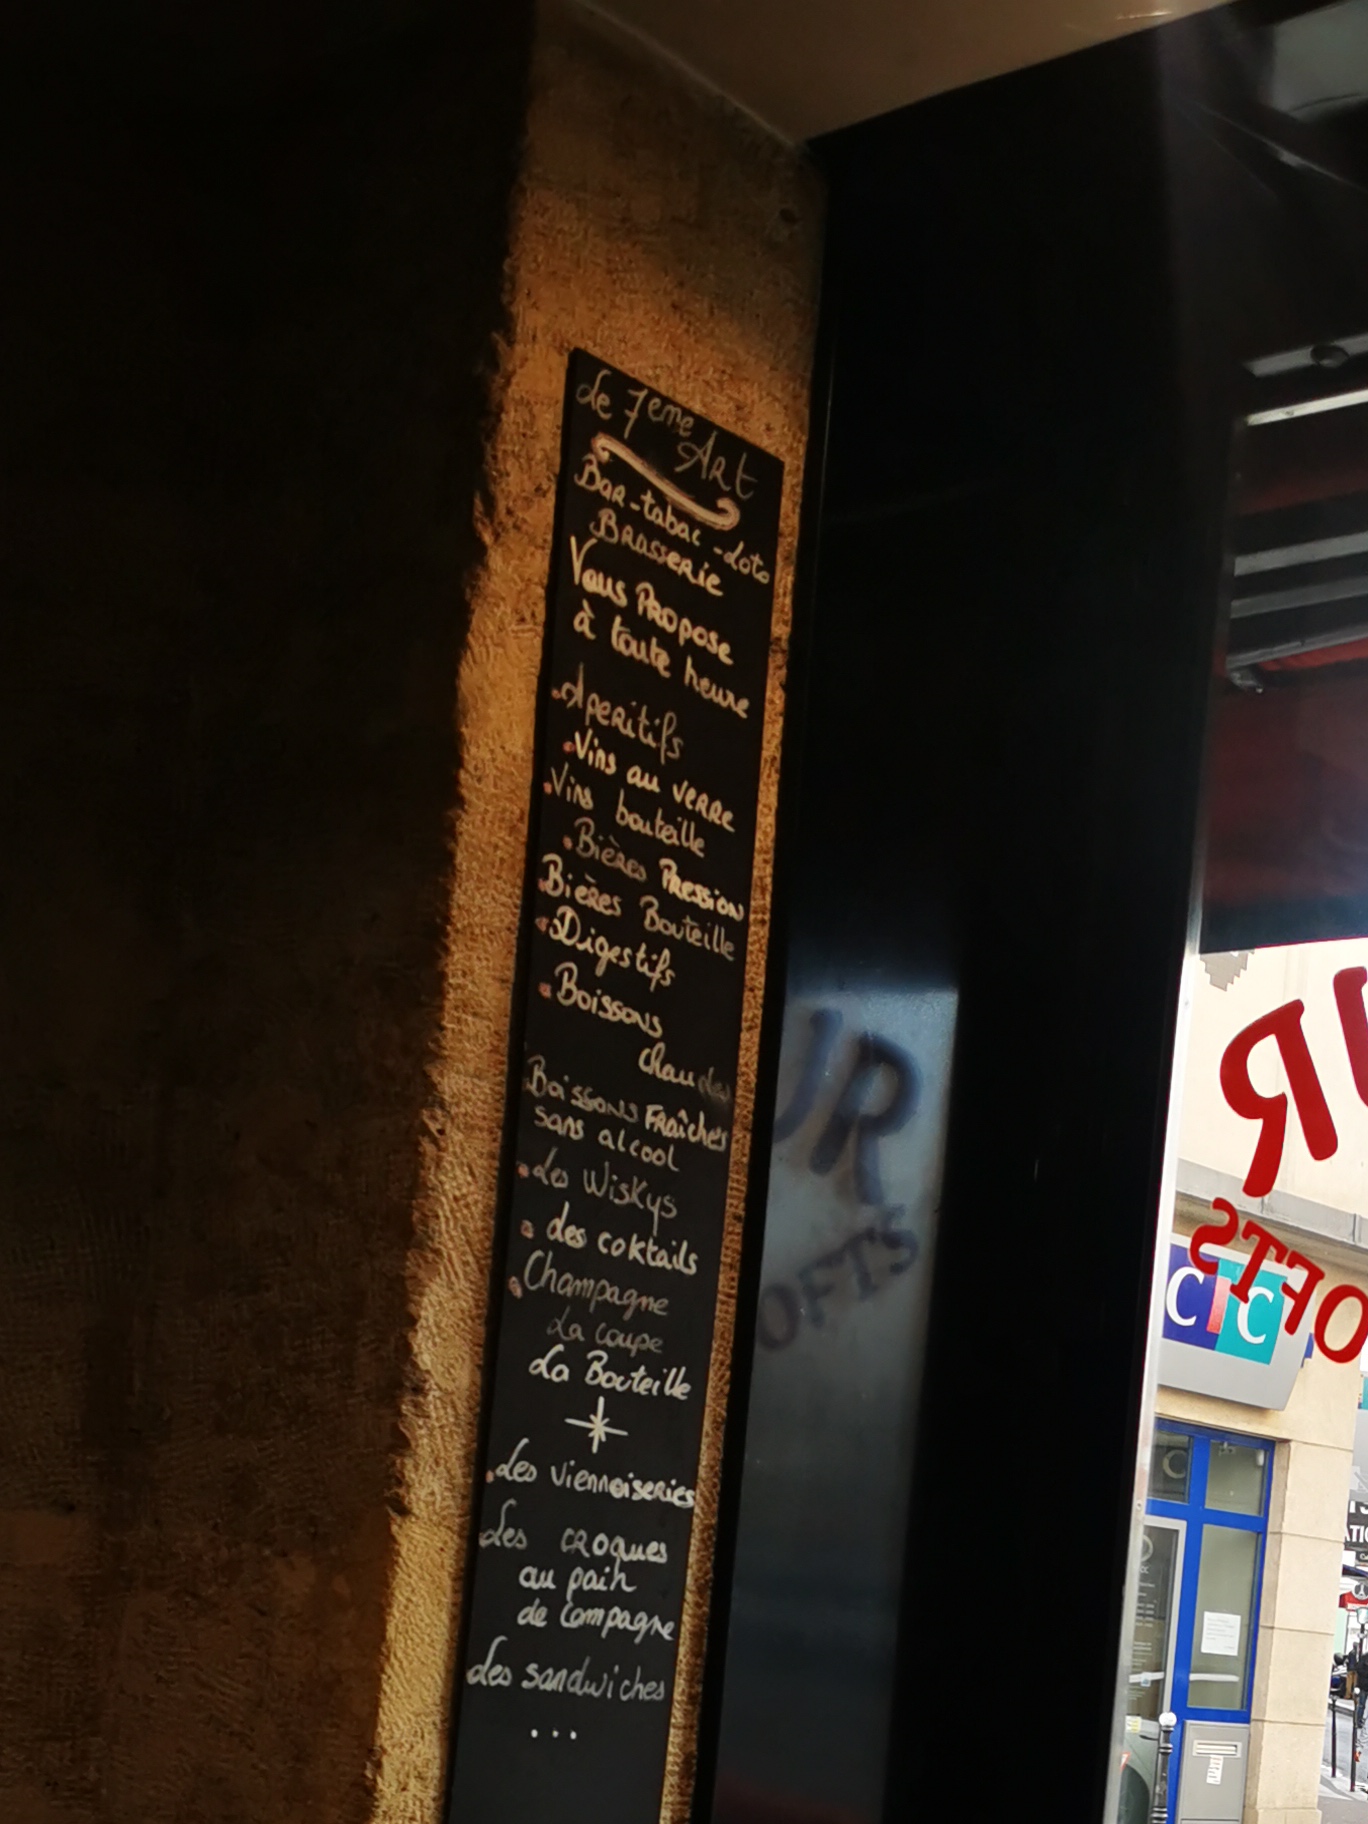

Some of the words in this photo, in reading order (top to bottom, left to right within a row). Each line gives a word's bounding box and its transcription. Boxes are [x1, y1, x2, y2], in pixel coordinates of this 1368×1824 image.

[570, 535, 628, 608] Vous
[573, 599, 597, 640] à
[611, 615, 671, 678] toute
[684, 655, 750, 719] heure
[574, 728, 616, 776] Vins
[626, 765, 660, 793] au
[615, 788, 705, 858] bouteille
[549, 905, 675, 992] Digestifs
[554, 962, 663, 1038] Boissons
[598, 1128, 679, 1173] alcool
[523, 1249, 669, 1321] Champagne
[518, 1565, 556, 1590] au
